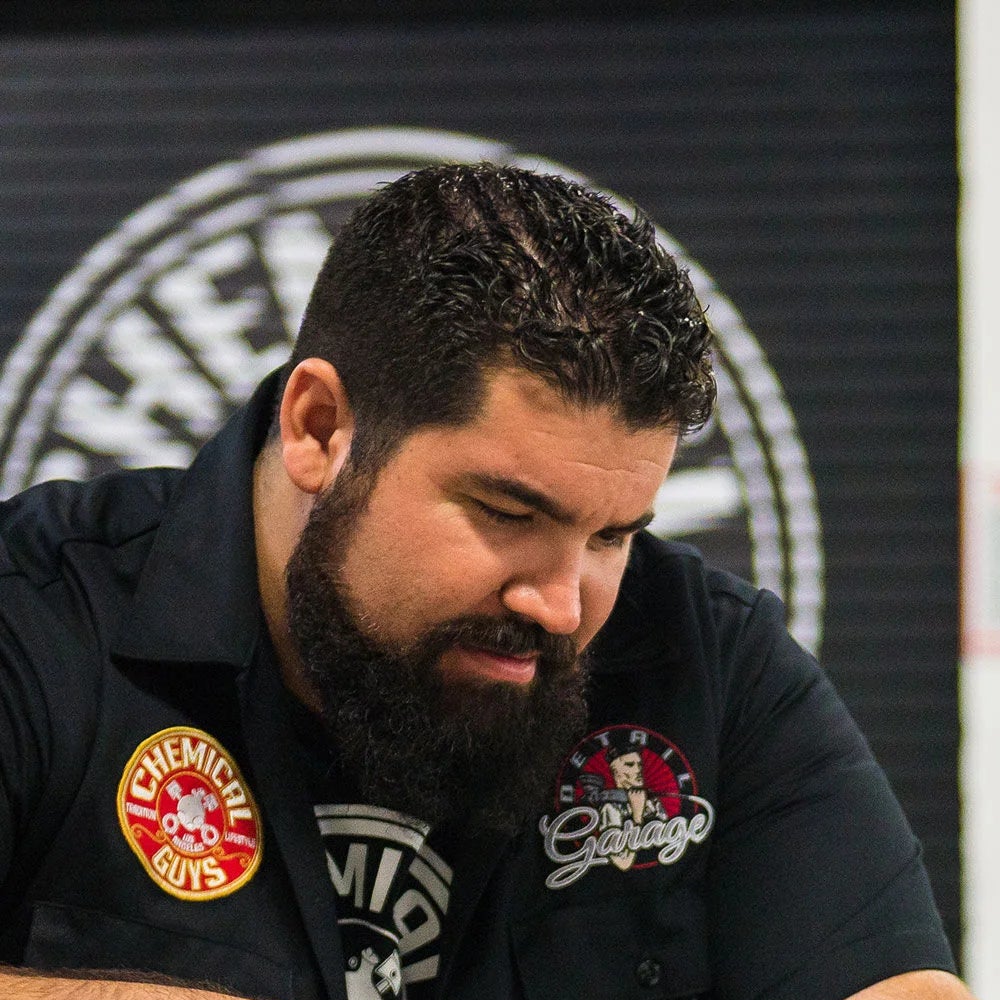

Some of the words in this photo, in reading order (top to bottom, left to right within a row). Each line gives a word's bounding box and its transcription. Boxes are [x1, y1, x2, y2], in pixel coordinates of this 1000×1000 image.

[131, 737, 252, 826] CHEMICAL
[560, 731, 691, 803] DETAIL
[152, 845, 227, 891] GUYS
[539, 795, 715, 889] Garage
